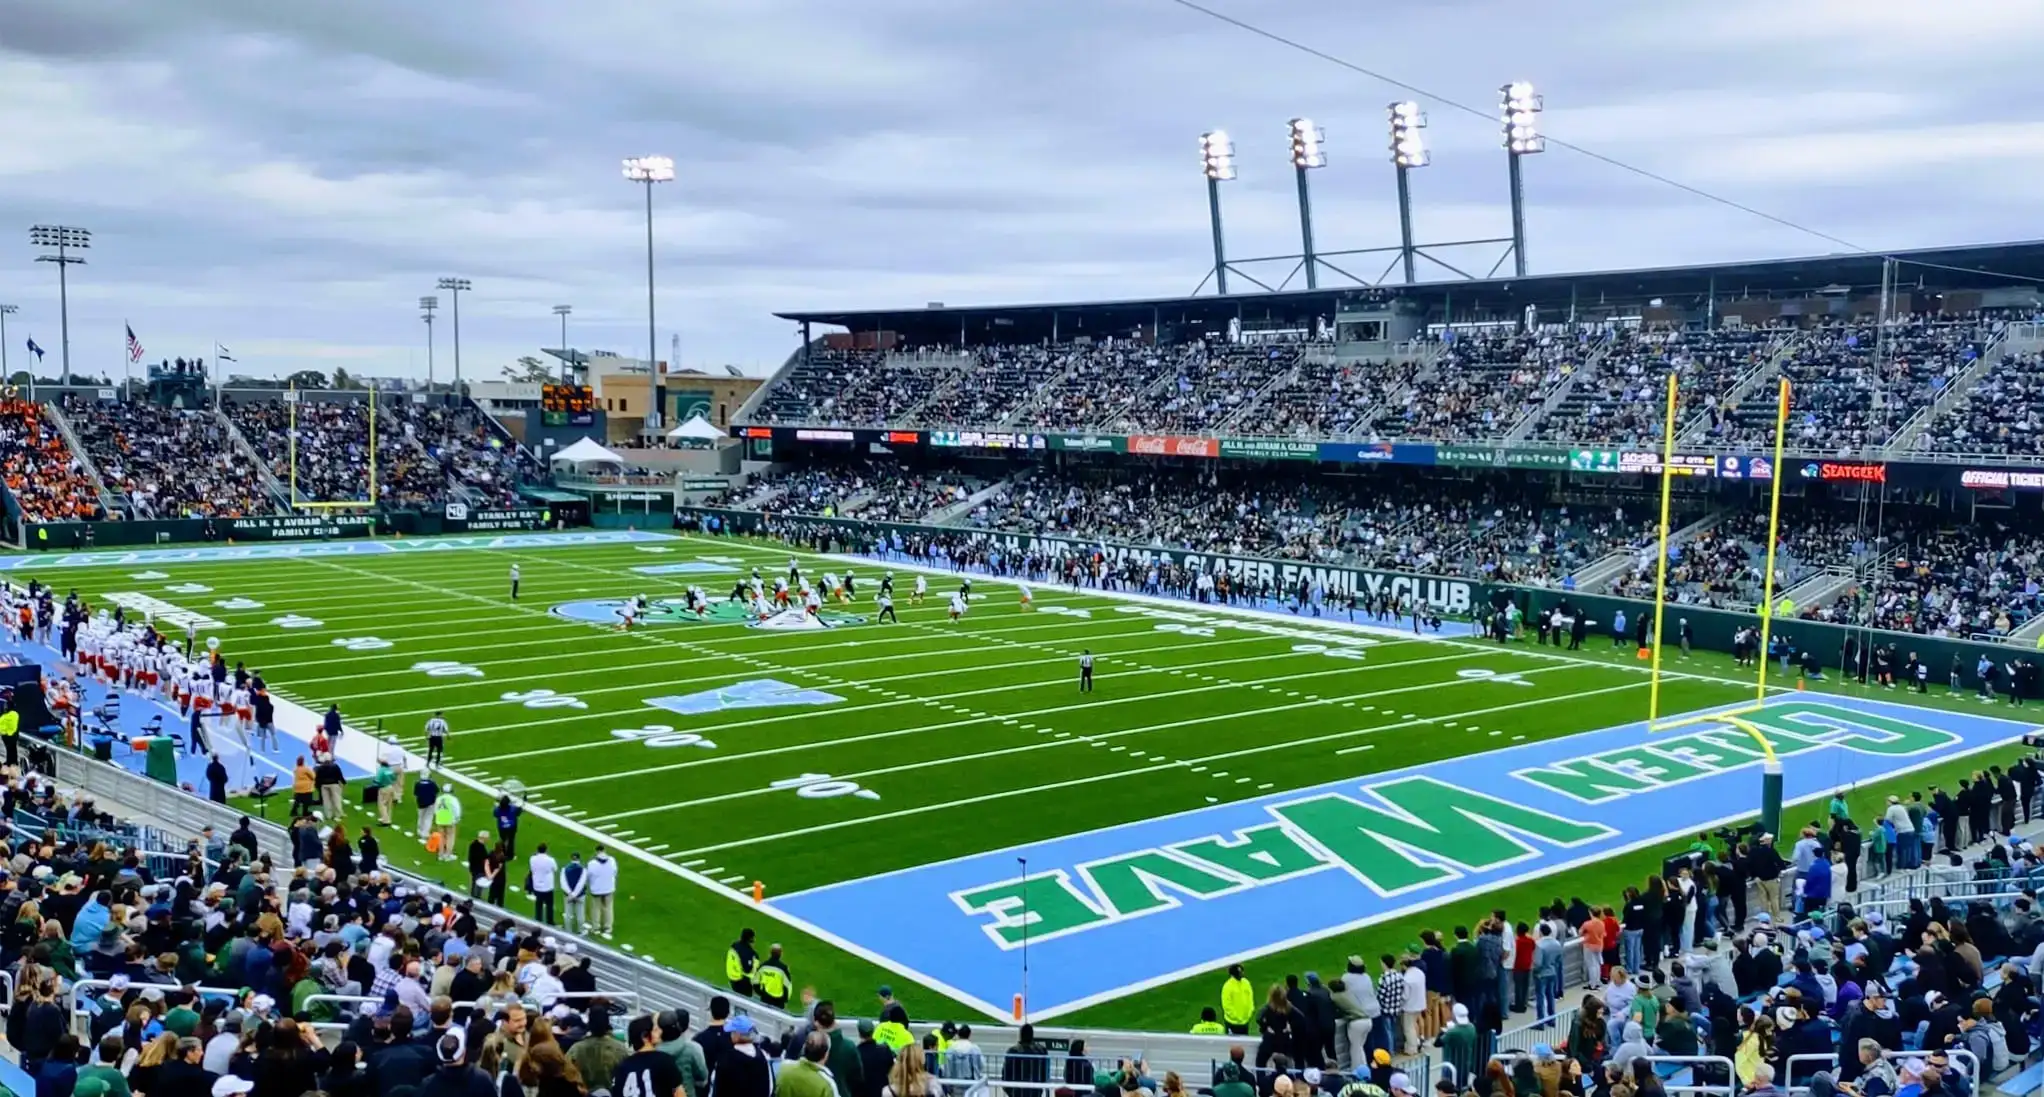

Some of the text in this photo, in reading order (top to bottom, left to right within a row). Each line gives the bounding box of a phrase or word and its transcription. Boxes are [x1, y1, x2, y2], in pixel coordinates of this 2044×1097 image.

[1136, 438, 1208, 454] Coca-Cola Coca-Cola
[1600, 452, 1611, 464] 7
[1822, 464, 1886, 482] SEATGEEK
[1961, 470, 2008, 484] OFFICIAL
[233, 520, 256, 528] JILL
[336, 516, 370, 524] GLAZE
[1281, 564, 1386, 600] FAMILY
[1391, 576, 1471, 614] CLUB
[501, 689, 578, 709] 30
[610, 724, 701, 748] 20
[769, 773, 860, 799] 10
[622, 1068, 657, 1097] 41
